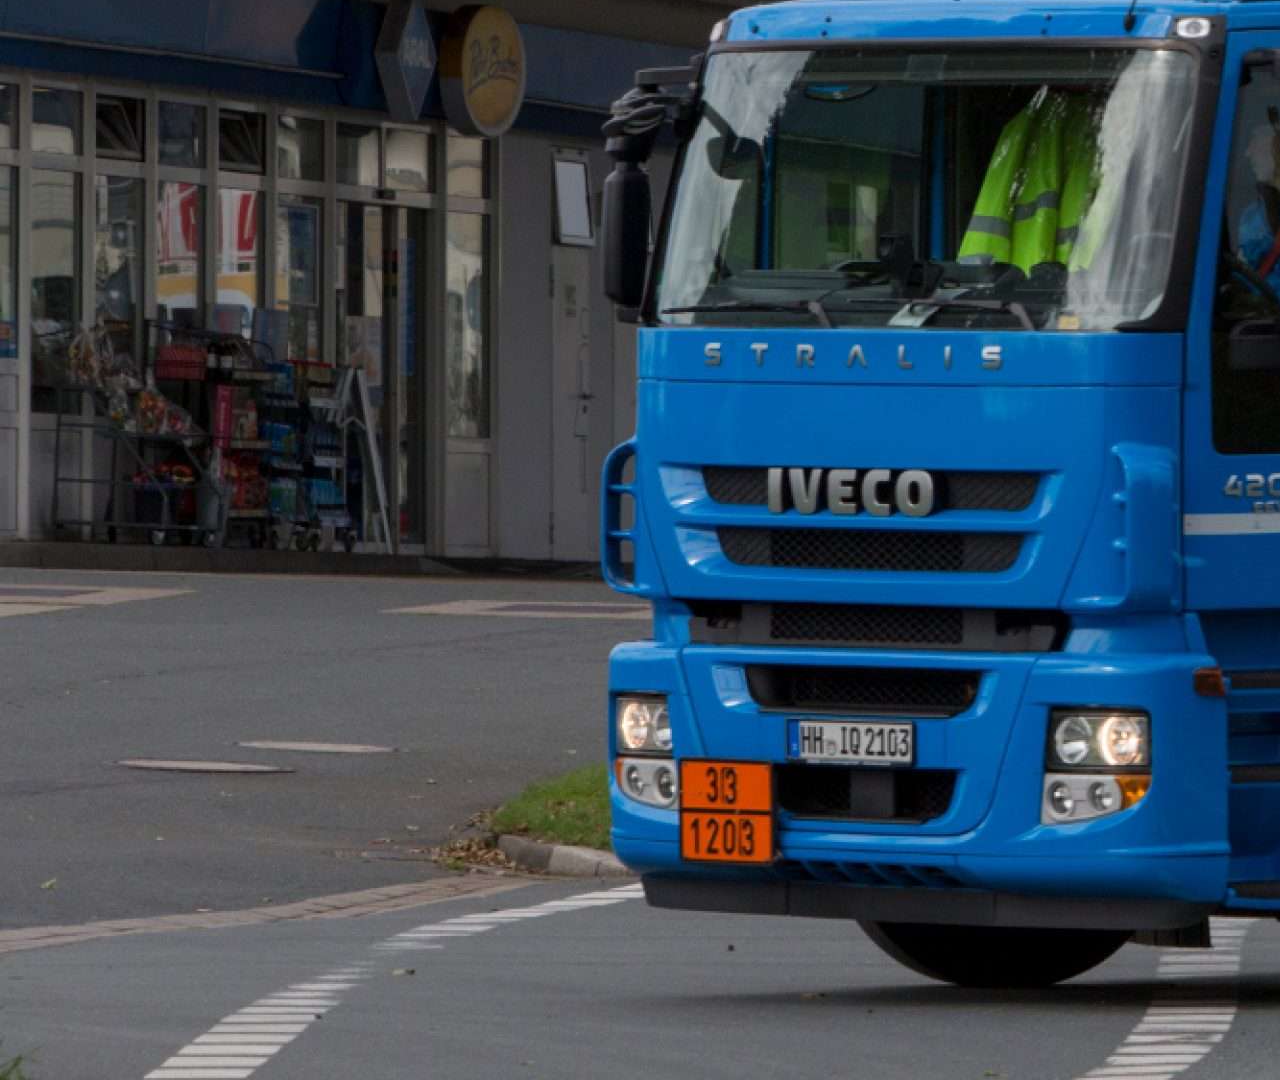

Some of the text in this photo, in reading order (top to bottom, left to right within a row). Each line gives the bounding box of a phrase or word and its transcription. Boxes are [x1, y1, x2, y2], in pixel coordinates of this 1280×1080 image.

[704, 343, 1003, 369] STRALIS
[767, 466, 935, 516] IVECO
[801, 726, 824, 754] HH
[865, 728, 909, 757] 2103
[706, 766, 737, 804] 33
[691, 818, 754, 857] 1203
